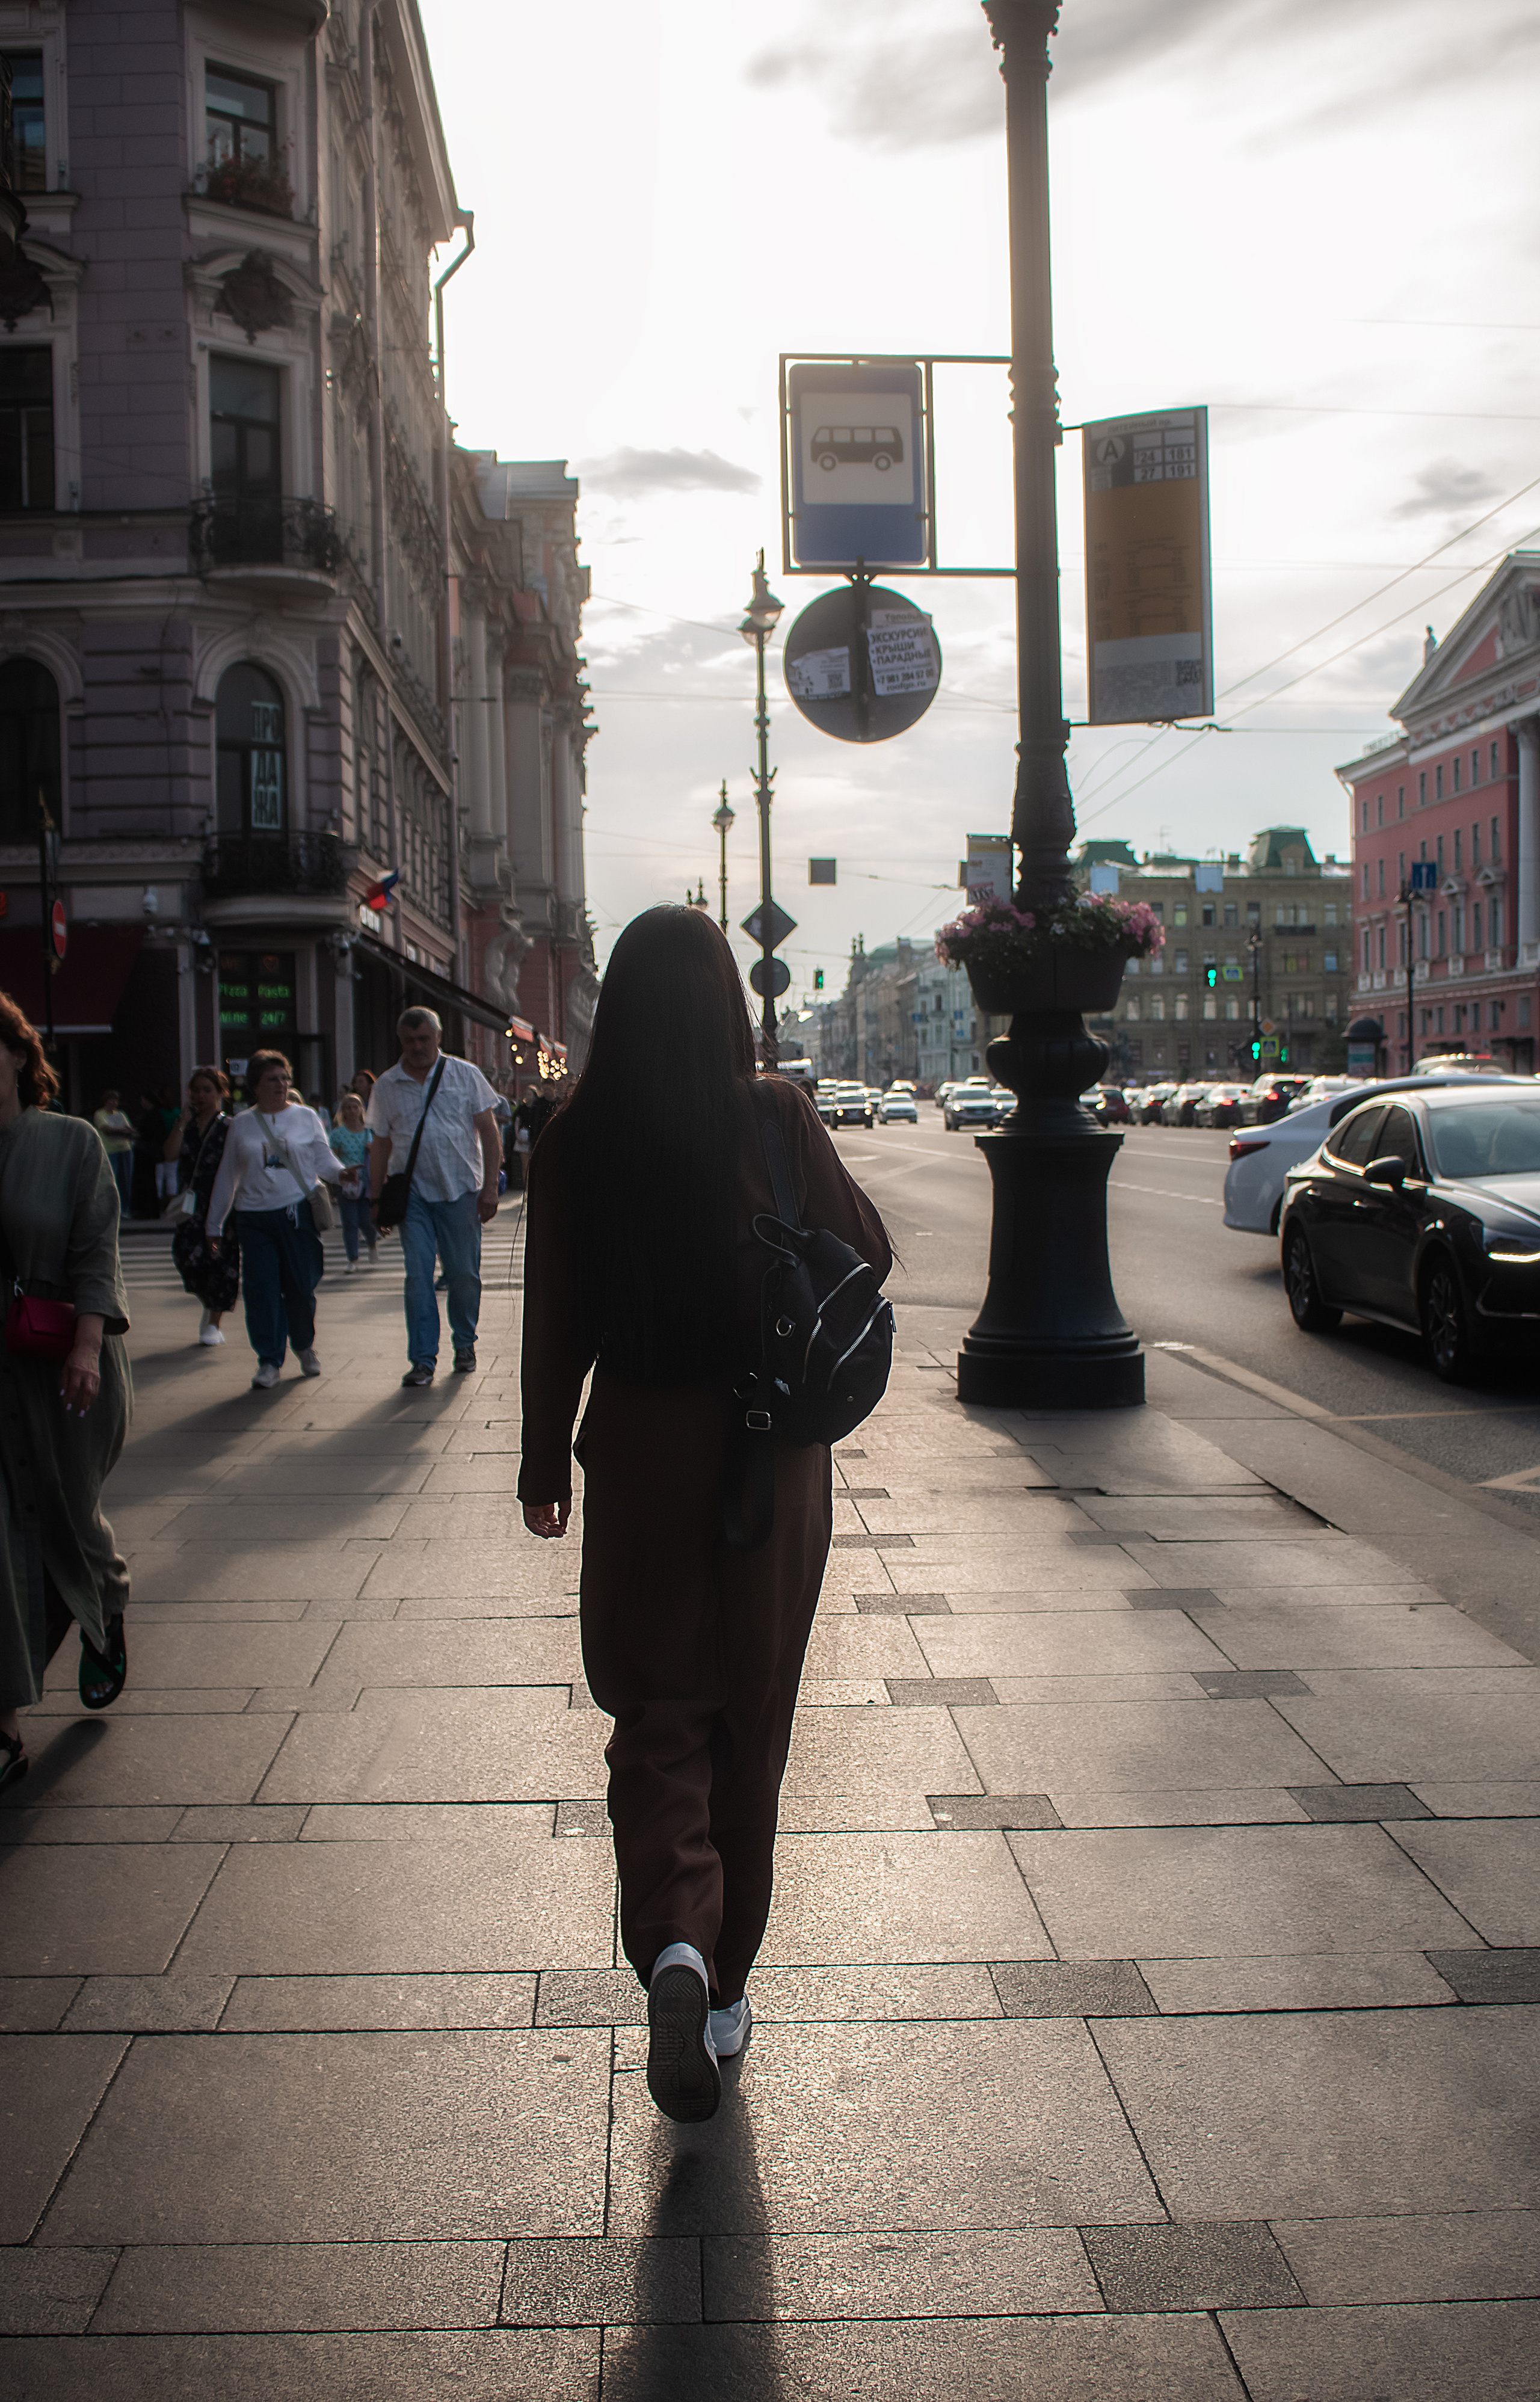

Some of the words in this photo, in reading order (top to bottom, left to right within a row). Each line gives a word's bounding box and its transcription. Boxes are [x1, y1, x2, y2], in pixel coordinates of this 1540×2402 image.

[1169, 447, 1190, 460] 181
[1141, 466, 1156, 480] 27
[1169, 464, 1190, 477] 191
